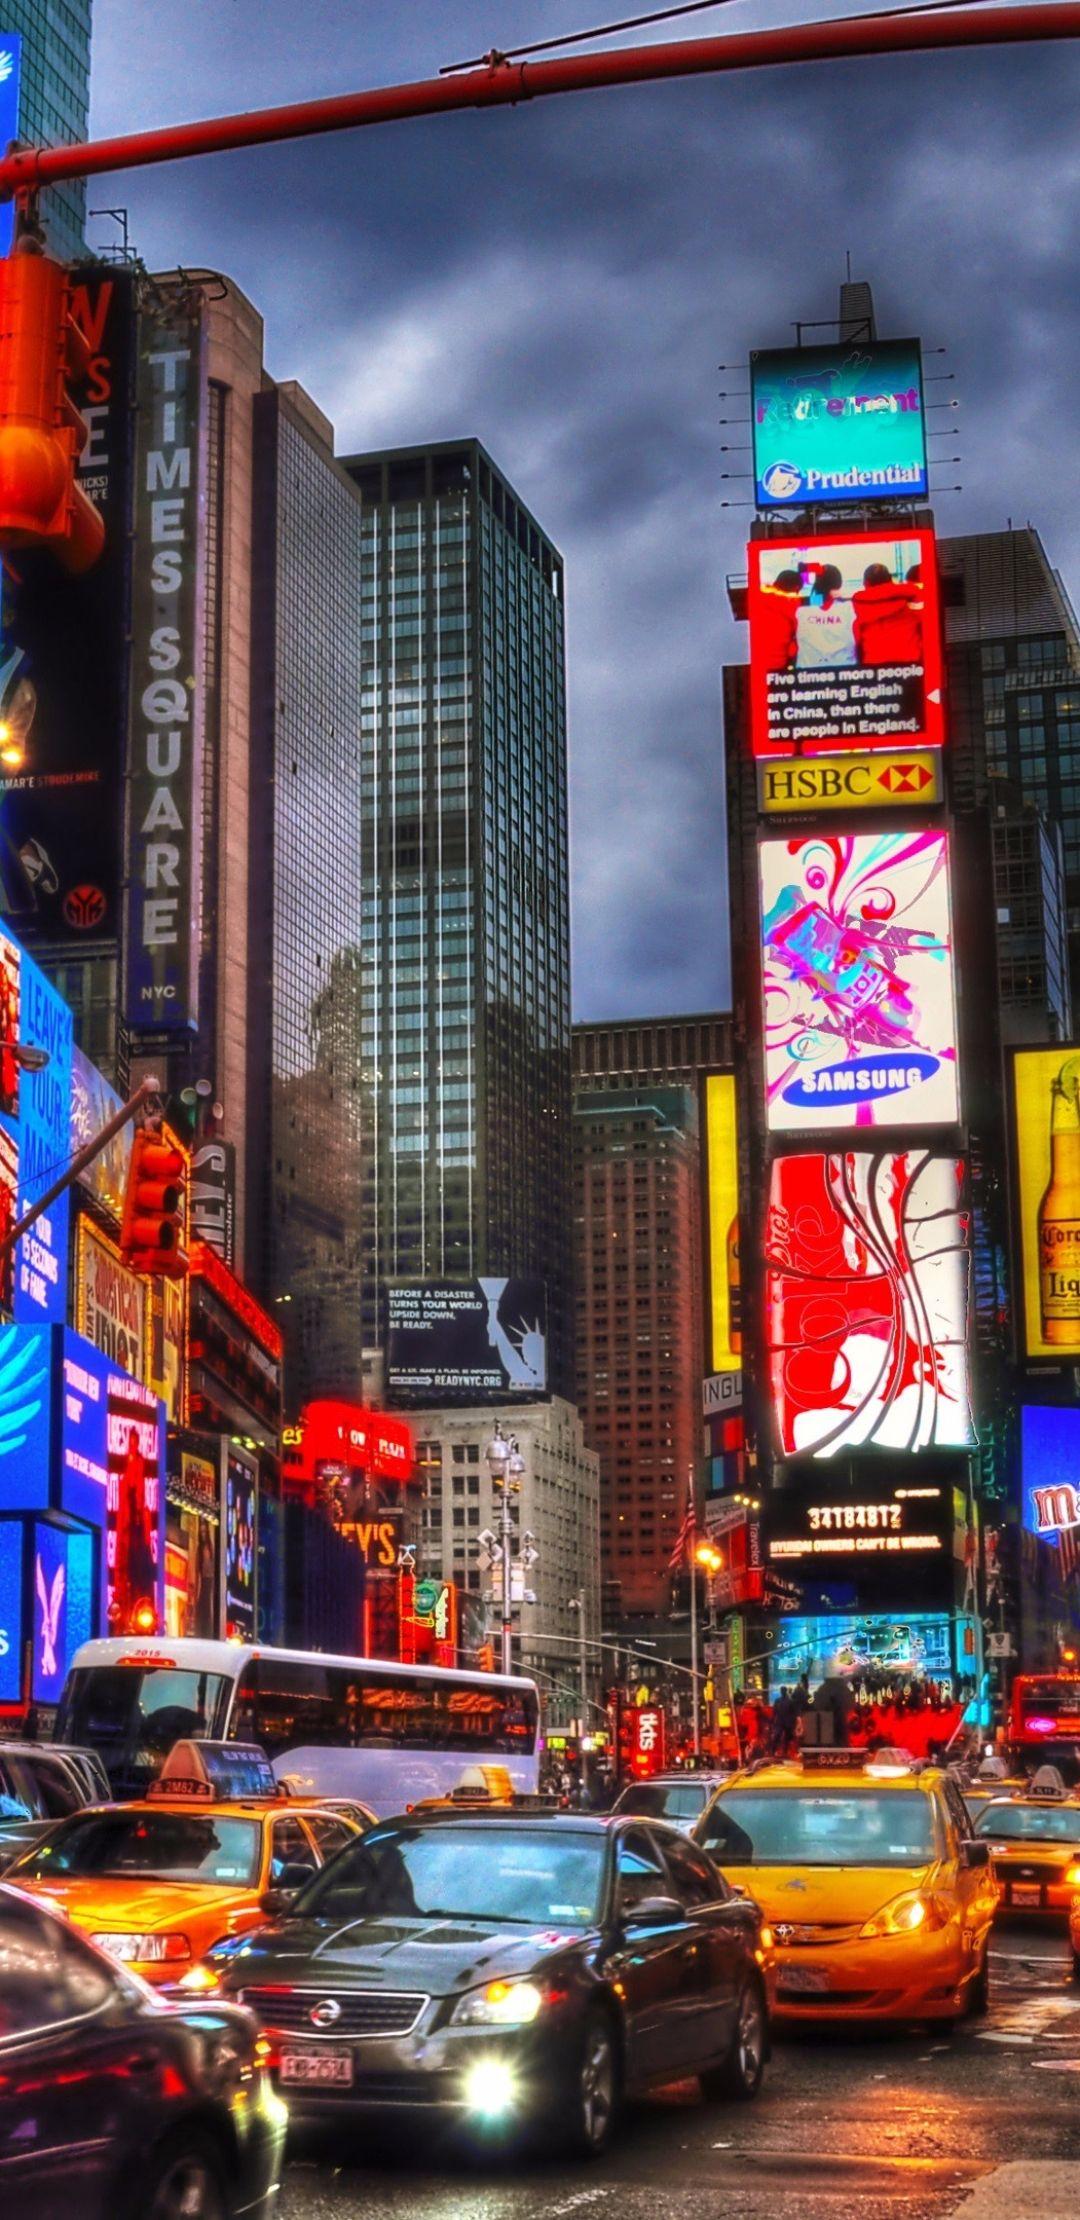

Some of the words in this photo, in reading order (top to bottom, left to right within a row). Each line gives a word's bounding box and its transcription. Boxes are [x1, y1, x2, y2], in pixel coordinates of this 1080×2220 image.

[757, 388, 919, 424] Retirement
[146, 350, 190, 595] TIMES
[806, 462, 921, 490] Prudential
[807, 615, 842, 625] CHINA
[766, 673, 795, 686] Five
[797, 671, 836, 684] times
[838, 669, 875, 681] more
[877, 664, 924, 681] people
[766, 692, 789, 704] are
[791, 687, 848, 702] learning
[850, 682, 903, 700] English
[783, 706, 828, 721] China,
[830, 704, 862, 717] than
[864, 702, 900, 715] there
[768, 728, 790, 739] are
[792, 723, 840, 740] people
[859, 717, 920, 735] England.
[141, 626, 189, 945] SQUARE
[765, 766, 872, 801] HSBC
[142, 985, 176, 999] NYC
[28, 974, 63, 1066] LEAVE
[801, 1067, 922, 1094] SAMSUNG
[32, 1069, 62, 1137] YOUR
[768, 1206, 790, 1267] Diet
[389, 1290, 422, 1298] BEFORE
[424, 1290, 432, 1298] A
[434, 1290, 475, 1299] DISASTER
[389, 1300, 419, 1308] TURNS
[421, 1301, 447, 1309] YOUR
[449, 1301, 483, 1310] WORLD
[389, 1310, 420, 1318] UPSIDE
[423, 1311, 456, 1320] DOWN,
[389, 1321, 400, 1329] BE
[402, 1321, 433, 1329] READY.
[434, 1376, 502, 1387] READYNYC.ORG
[750, 1521, 760, 1566] Travelex
[856, 1537, 887, 1550] CAN'T
[639, 1712, 659, 1751] tkts
